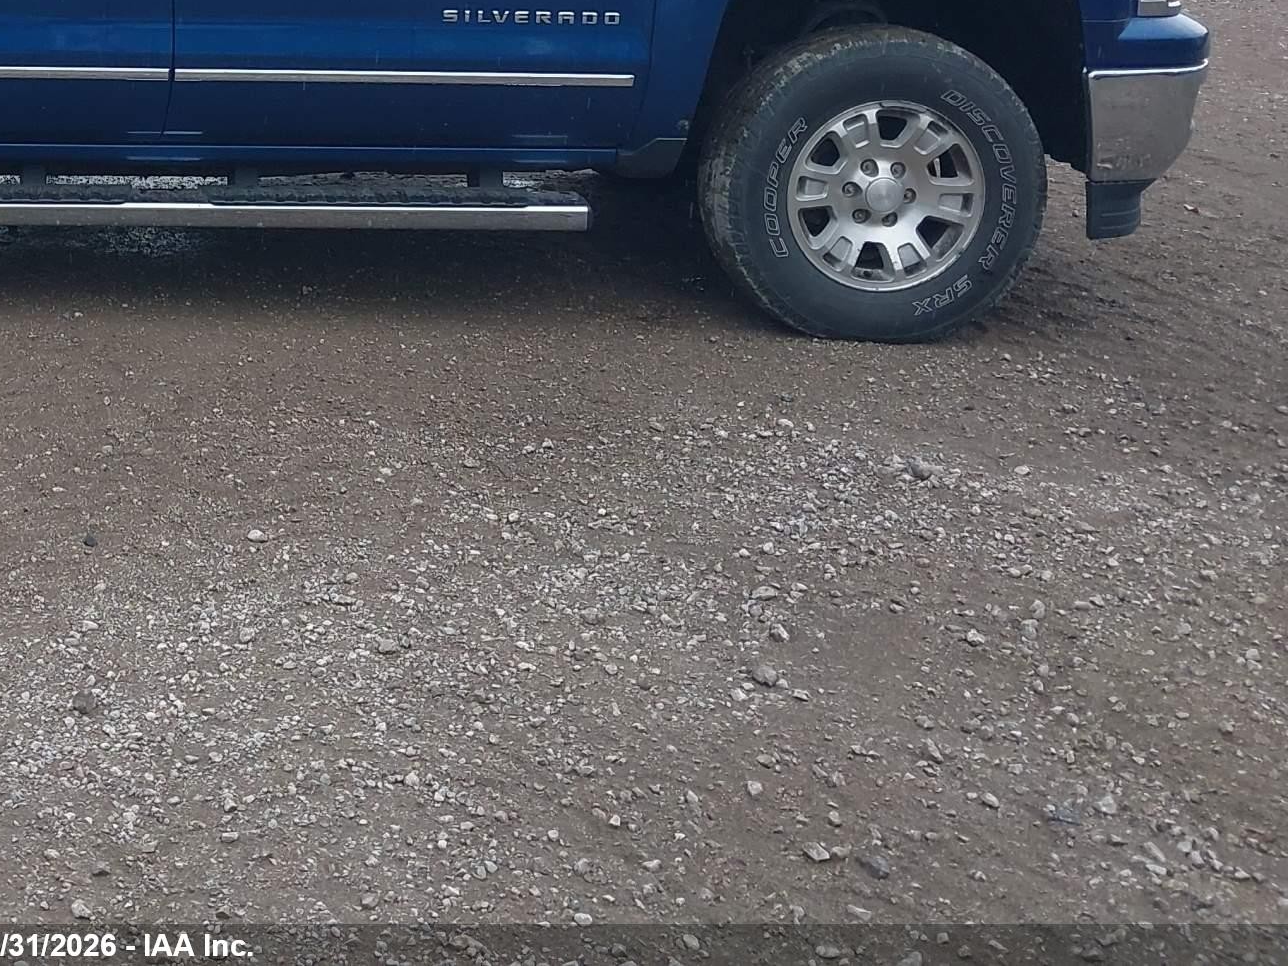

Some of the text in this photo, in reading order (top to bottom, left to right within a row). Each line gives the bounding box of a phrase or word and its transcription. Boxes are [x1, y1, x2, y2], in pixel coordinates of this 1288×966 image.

[442, 9, 621, 25] SILVERADO
[763, 89, 1017, 316] COOPER DISCOVERER SRX
